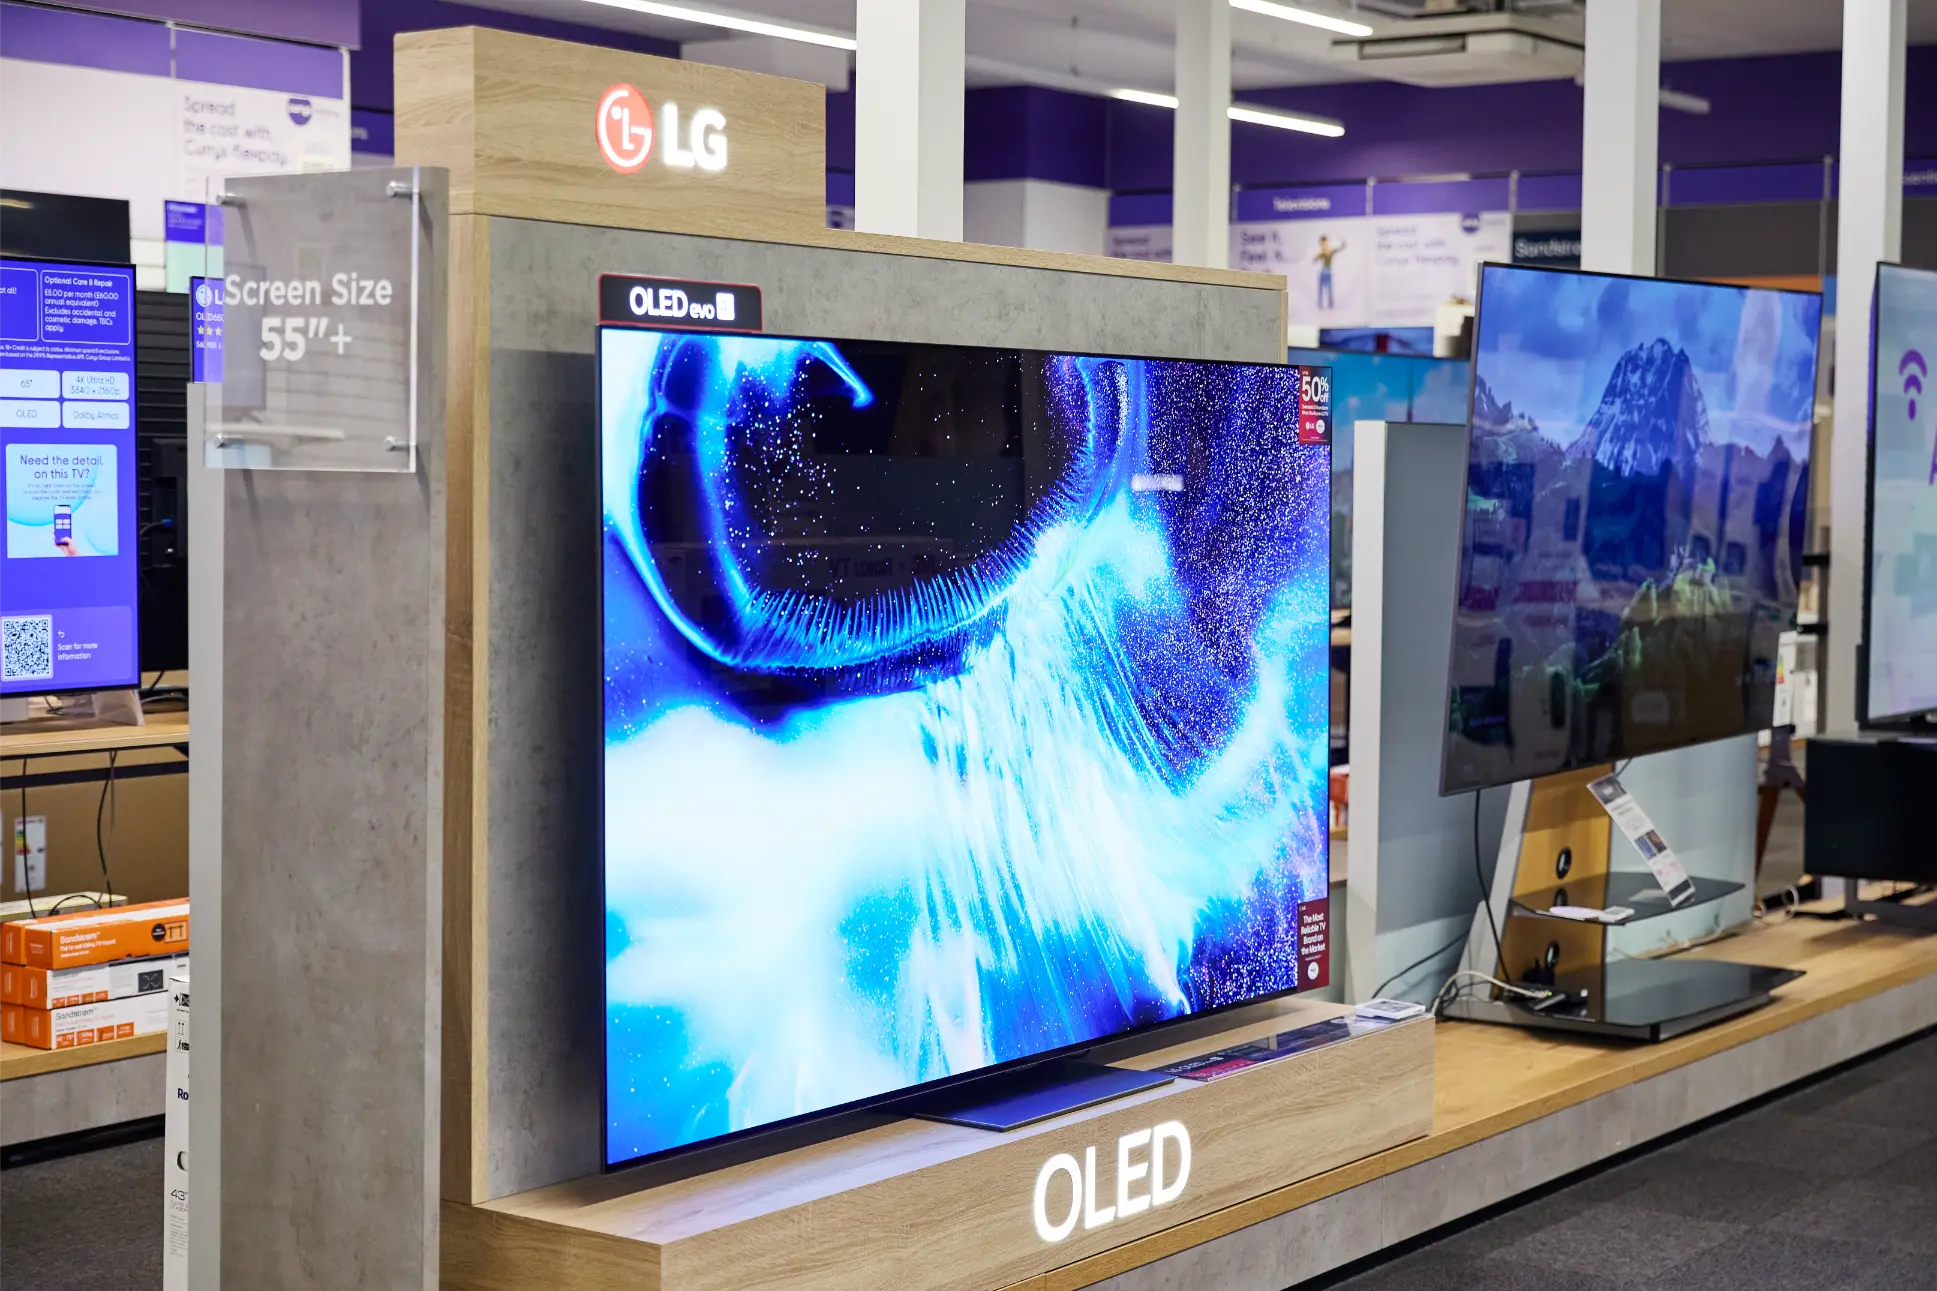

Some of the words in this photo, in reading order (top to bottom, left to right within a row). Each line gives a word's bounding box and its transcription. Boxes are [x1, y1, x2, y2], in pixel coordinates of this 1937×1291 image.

[184, 119, 206, 133] the
[211, 124, 238, 137] cost
[662, 102, 728, 171] LG
[44, 275, 72, 286] Optional
[73, 277, 88, 286] Care
[94, 278, 113, 288] Repair
[7, 286, 17, 295] all!
[44, 289, 63, 297] £5.00
[63, 290, 75, 298] per
[75, 291, 93, 299] month
[224, 274, 322, 305] Screen
[331, 272, 393, 305] Size
[44, 298, 65, 306] annual
[66, 299, 99, 308] equivalent)
[629, 286, 688, 318] OLED
[689, 303, 715, 320] evo
[44, 307, 71, 315] Excludes
[72, 308, 103, 317] accidental
[44, 316, 71, 324] cosmetic
[75, 375, 85, 383] 4K
[86, 375, 104, 384] Ultra
[105, 376, 115, 385] HD
[16, 409, 38, 418] OLED
[73, 410, 95, 420] Dolby
[96, 411, 119, 420] Atmos
[20, 455, 49, 466] Need
[52, 455, 69, 466] the
[72, 455, 103, 466] detail
[34, 470, 48, 479] on
[51, 469, 68, 479] this
[71, 468, 90, 479] TV?
[57, 643, 73, 651] Scan
[73, 642, 82, 650] for
[1303, 915, 1312, 924] The
[1312, 912, 1324, 922] Most
[1300, 924, 1319, 935] Reliable
[1319, 922, 1326, 931] TV
[1303, 934, 1317, 945] Brand
[1317, 933, 1324, 941] on
[1301, 946, 1309, 956] the
[1309, 943, 1326, 954] Market
[1033, 1121, 1193, 1243] OLED
